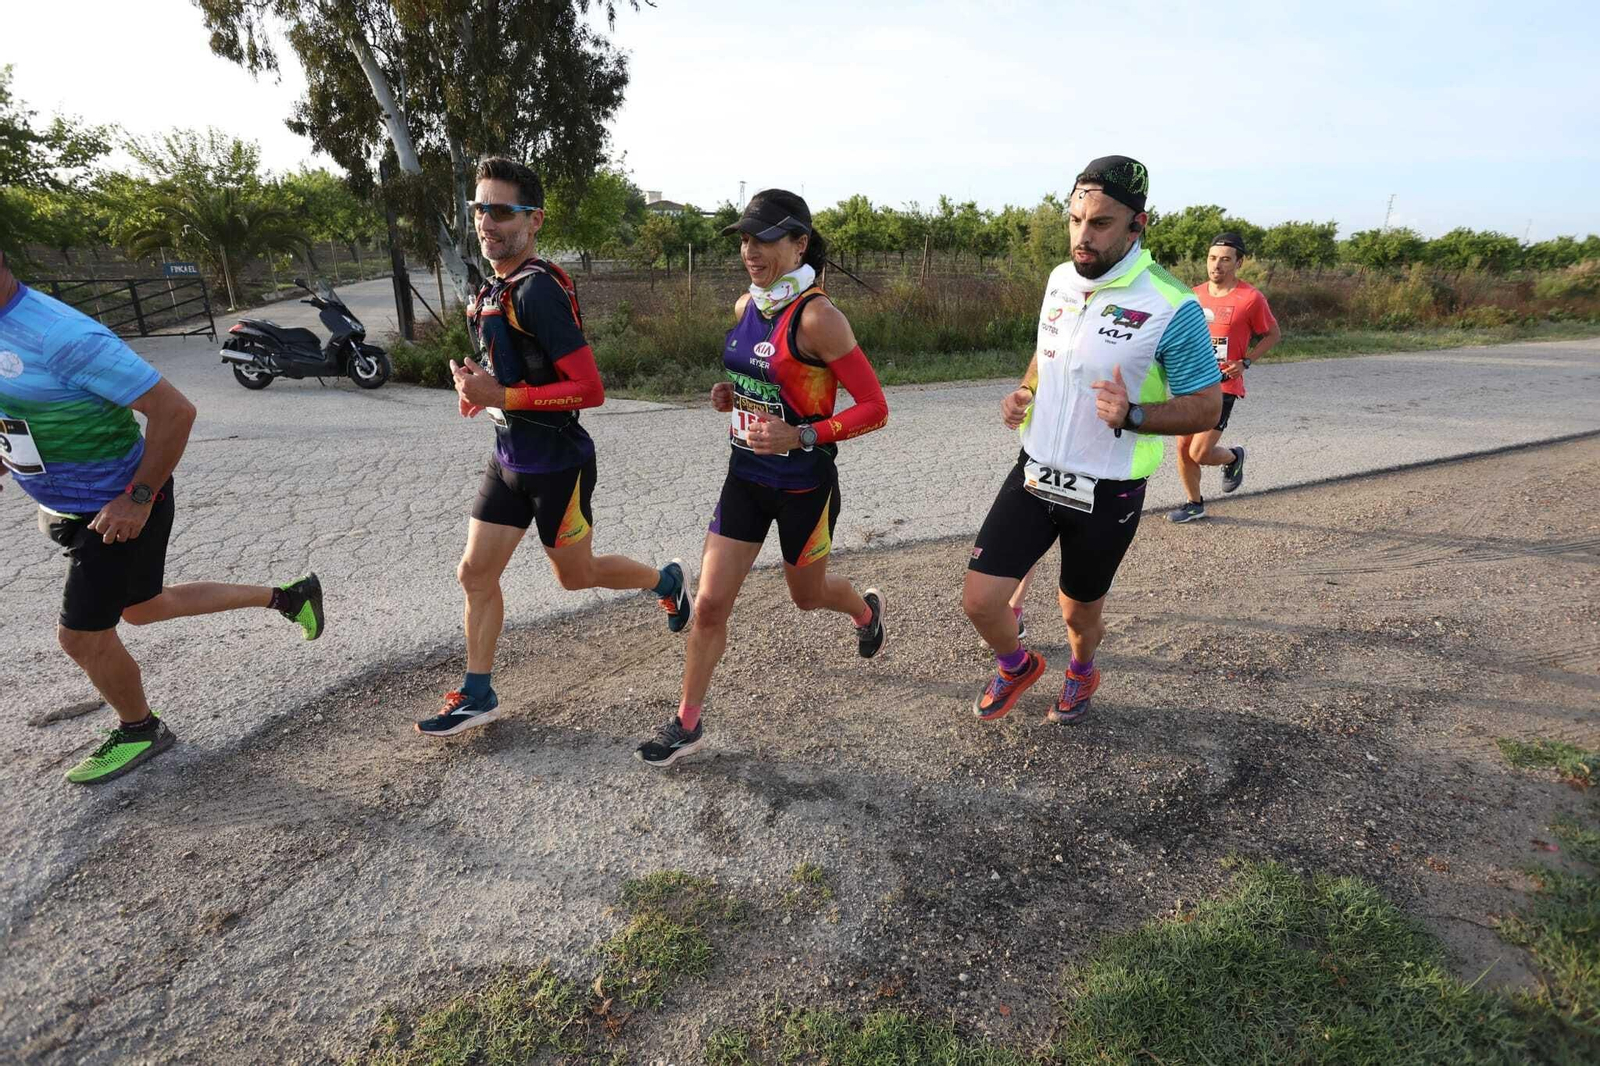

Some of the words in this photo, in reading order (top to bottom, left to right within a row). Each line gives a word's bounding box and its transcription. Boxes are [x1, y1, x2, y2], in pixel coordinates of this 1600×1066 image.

[755, 345, 771, 356] KIA
[749, 357, 770, 369] VEYSER
[534, 396, 583, 405] españa
[1038, 466, 1077, 491] 212
